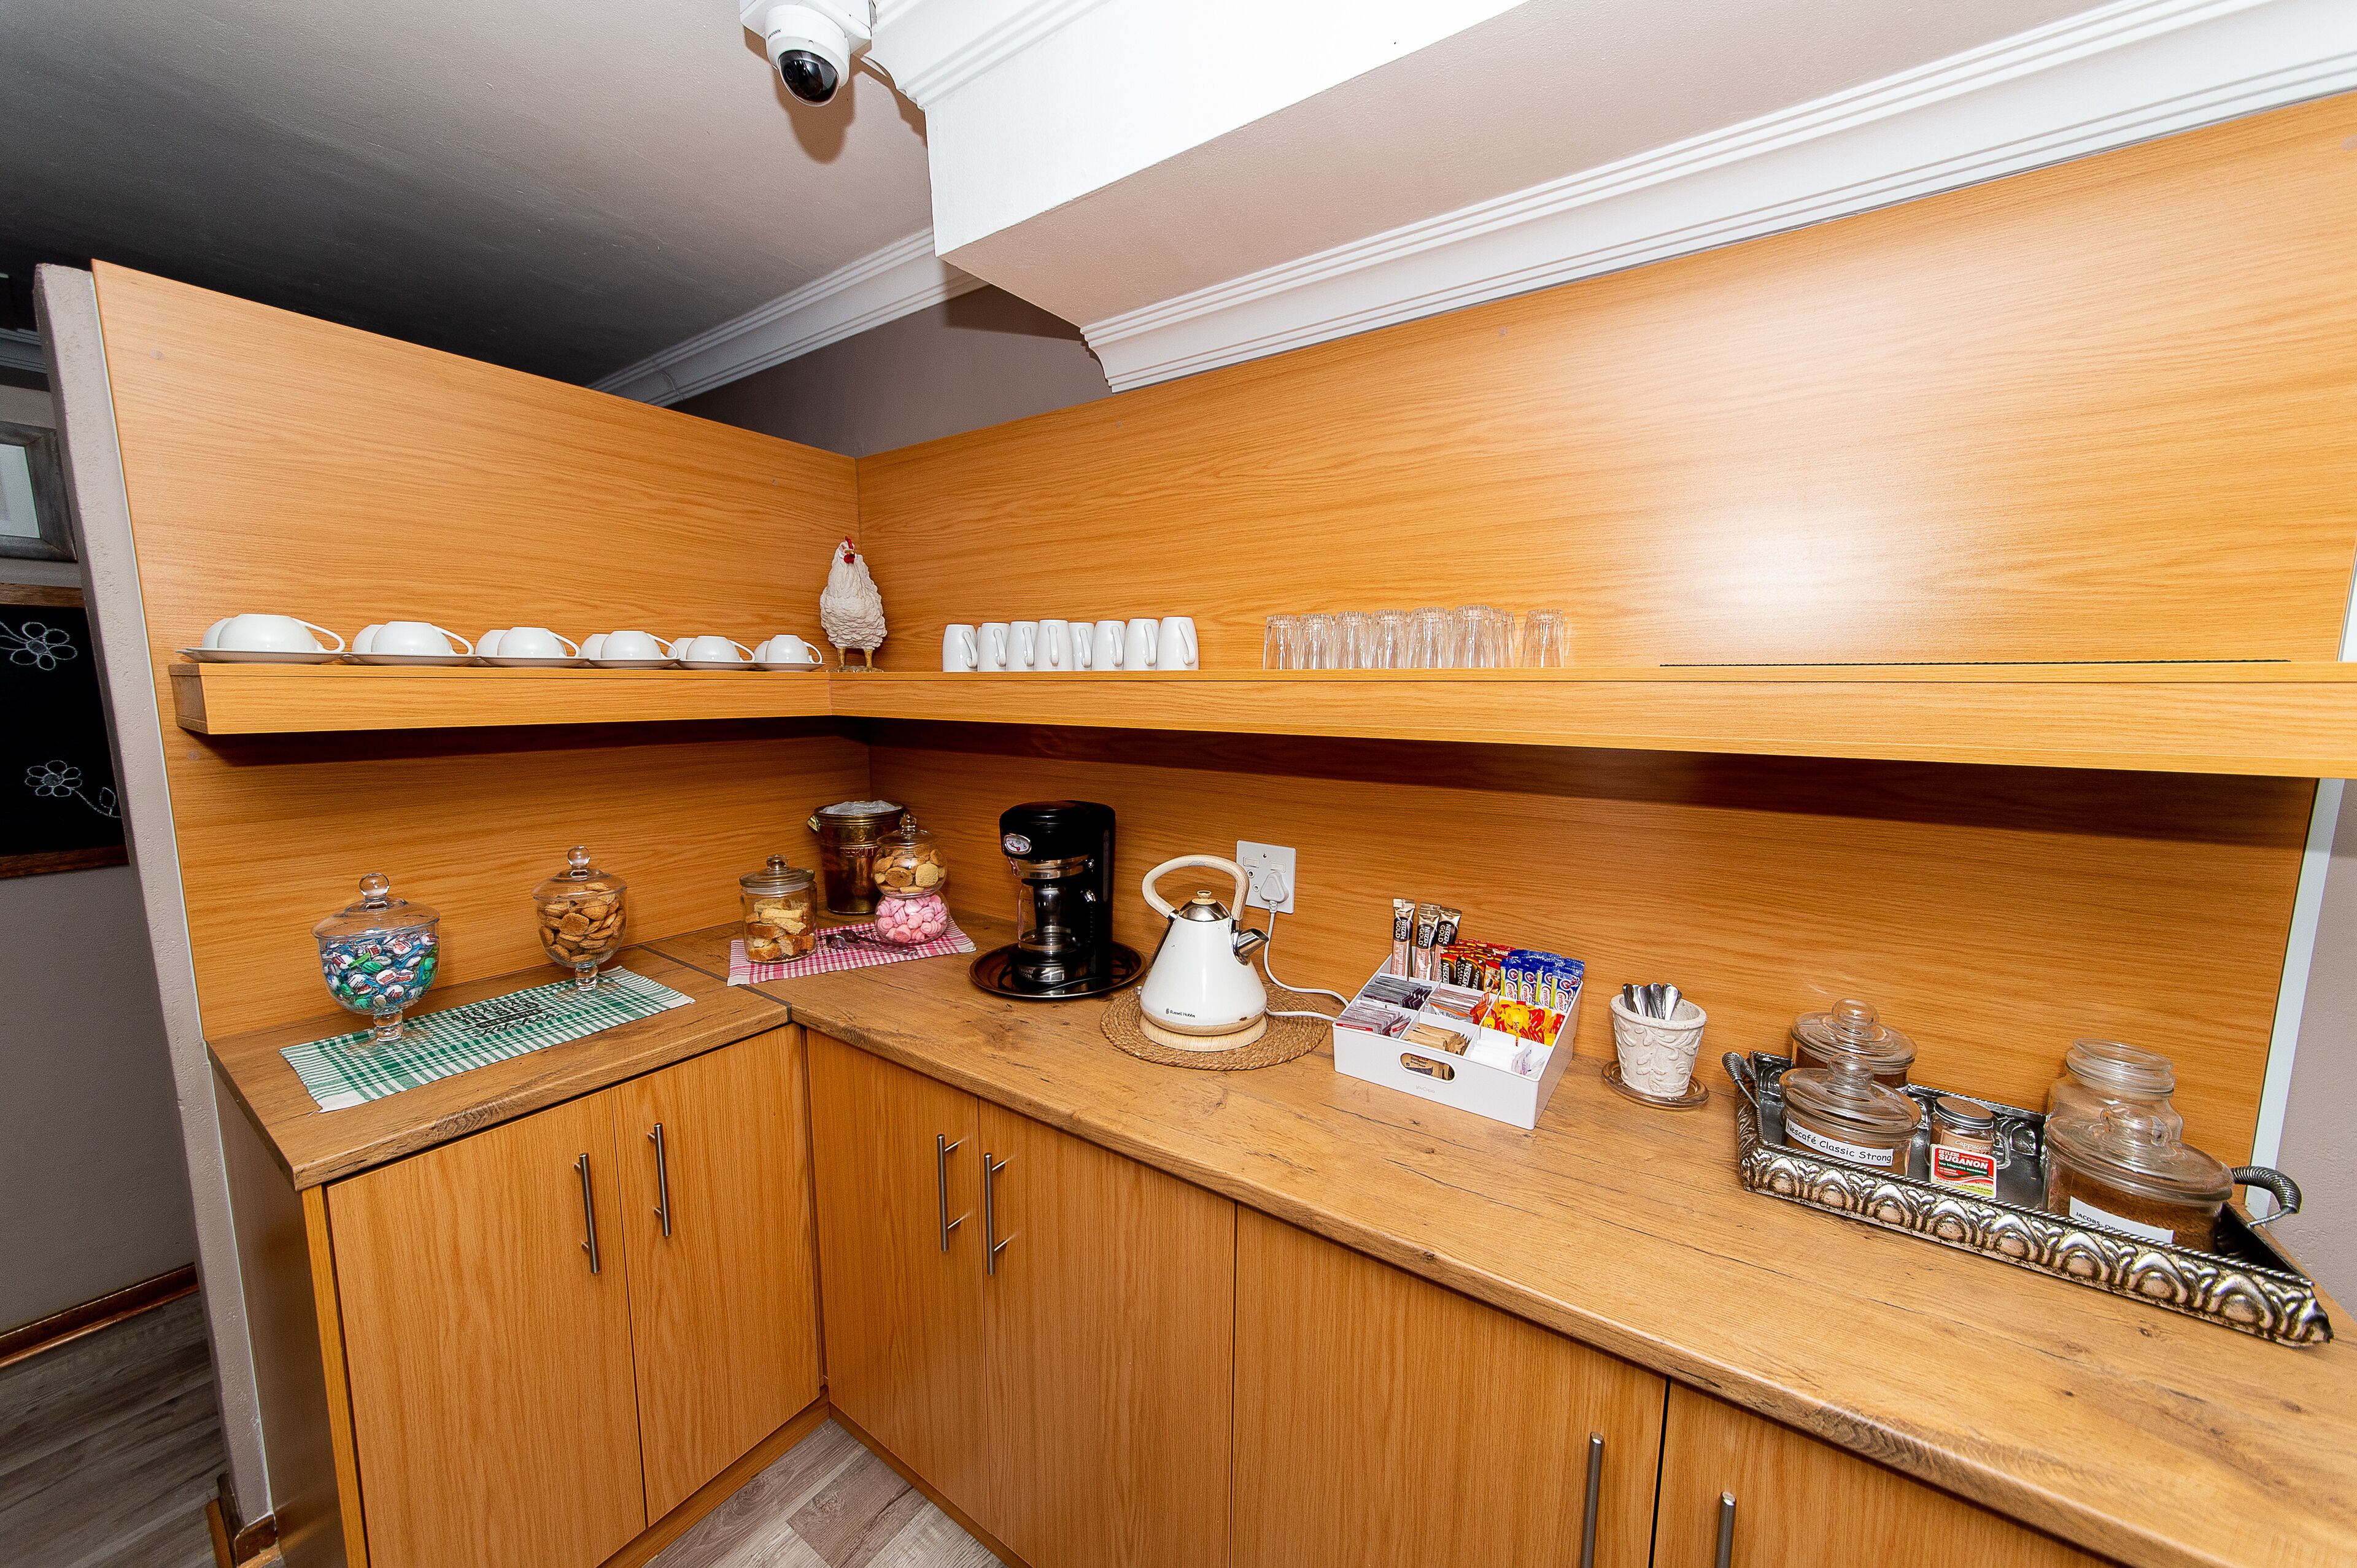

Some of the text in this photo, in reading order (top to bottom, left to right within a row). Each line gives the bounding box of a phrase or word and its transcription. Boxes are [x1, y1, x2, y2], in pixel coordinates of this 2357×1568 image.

[1787, 1122, 1892, 1164] Nescafé Classic Strong
[1955, 1140, 1991, 1150] Cappuccino
[1938, 1154, 1989, 1170] SUGANON
